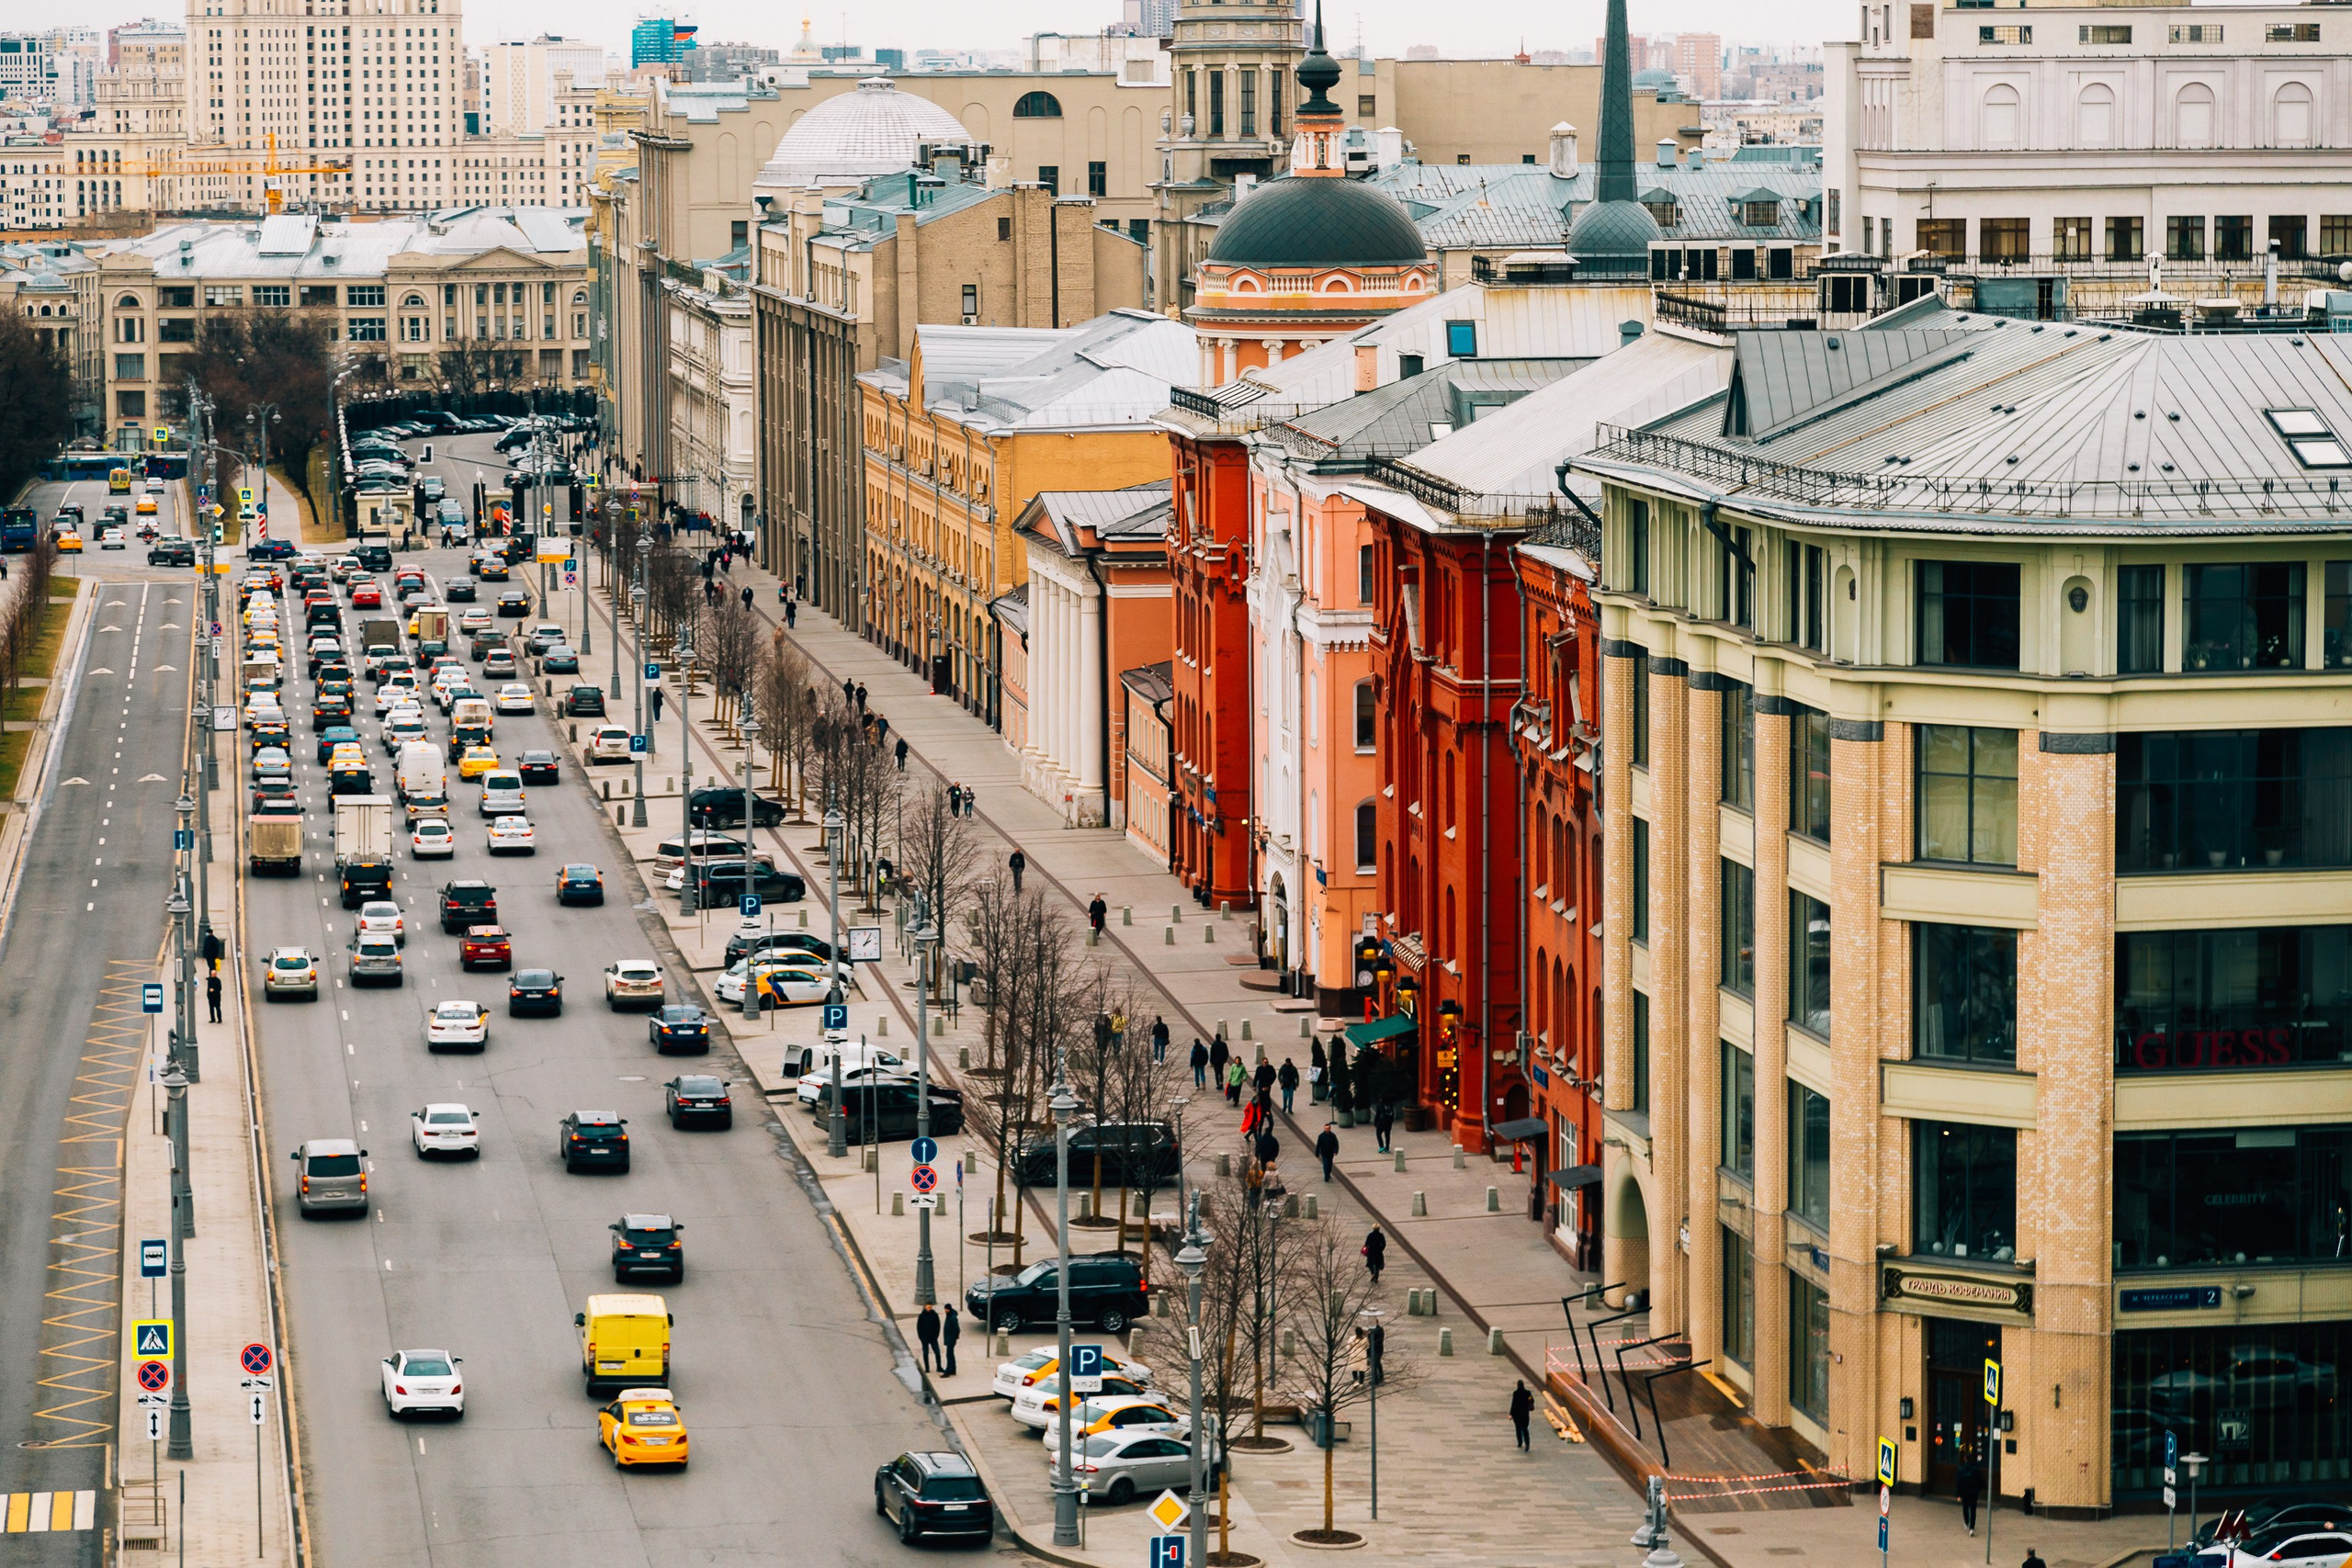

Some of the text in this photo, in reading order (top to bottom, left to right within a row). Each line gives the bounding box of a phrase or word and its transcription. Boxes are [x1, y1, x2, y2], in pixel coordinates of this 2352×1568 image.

[649, 665, 658, 677] P
[634, 737, 644, 750] P
[745, 897, 757, 913] P
[831, 1008, 843, 1026] P
[2134, 1028, 2290, 1069] GUESS
[2204, 1192, 2267, 1206] CELEBRITY
[1948, 1283, 2011, 1302] КОФЕМАНИЯ
[2207, 1290, 2216, 1304] 2
[1080, 1348, 1096, 1372] P
[2167, 1437, 2176, 1461] P
[2213, 1508, 2253, 1540] М
